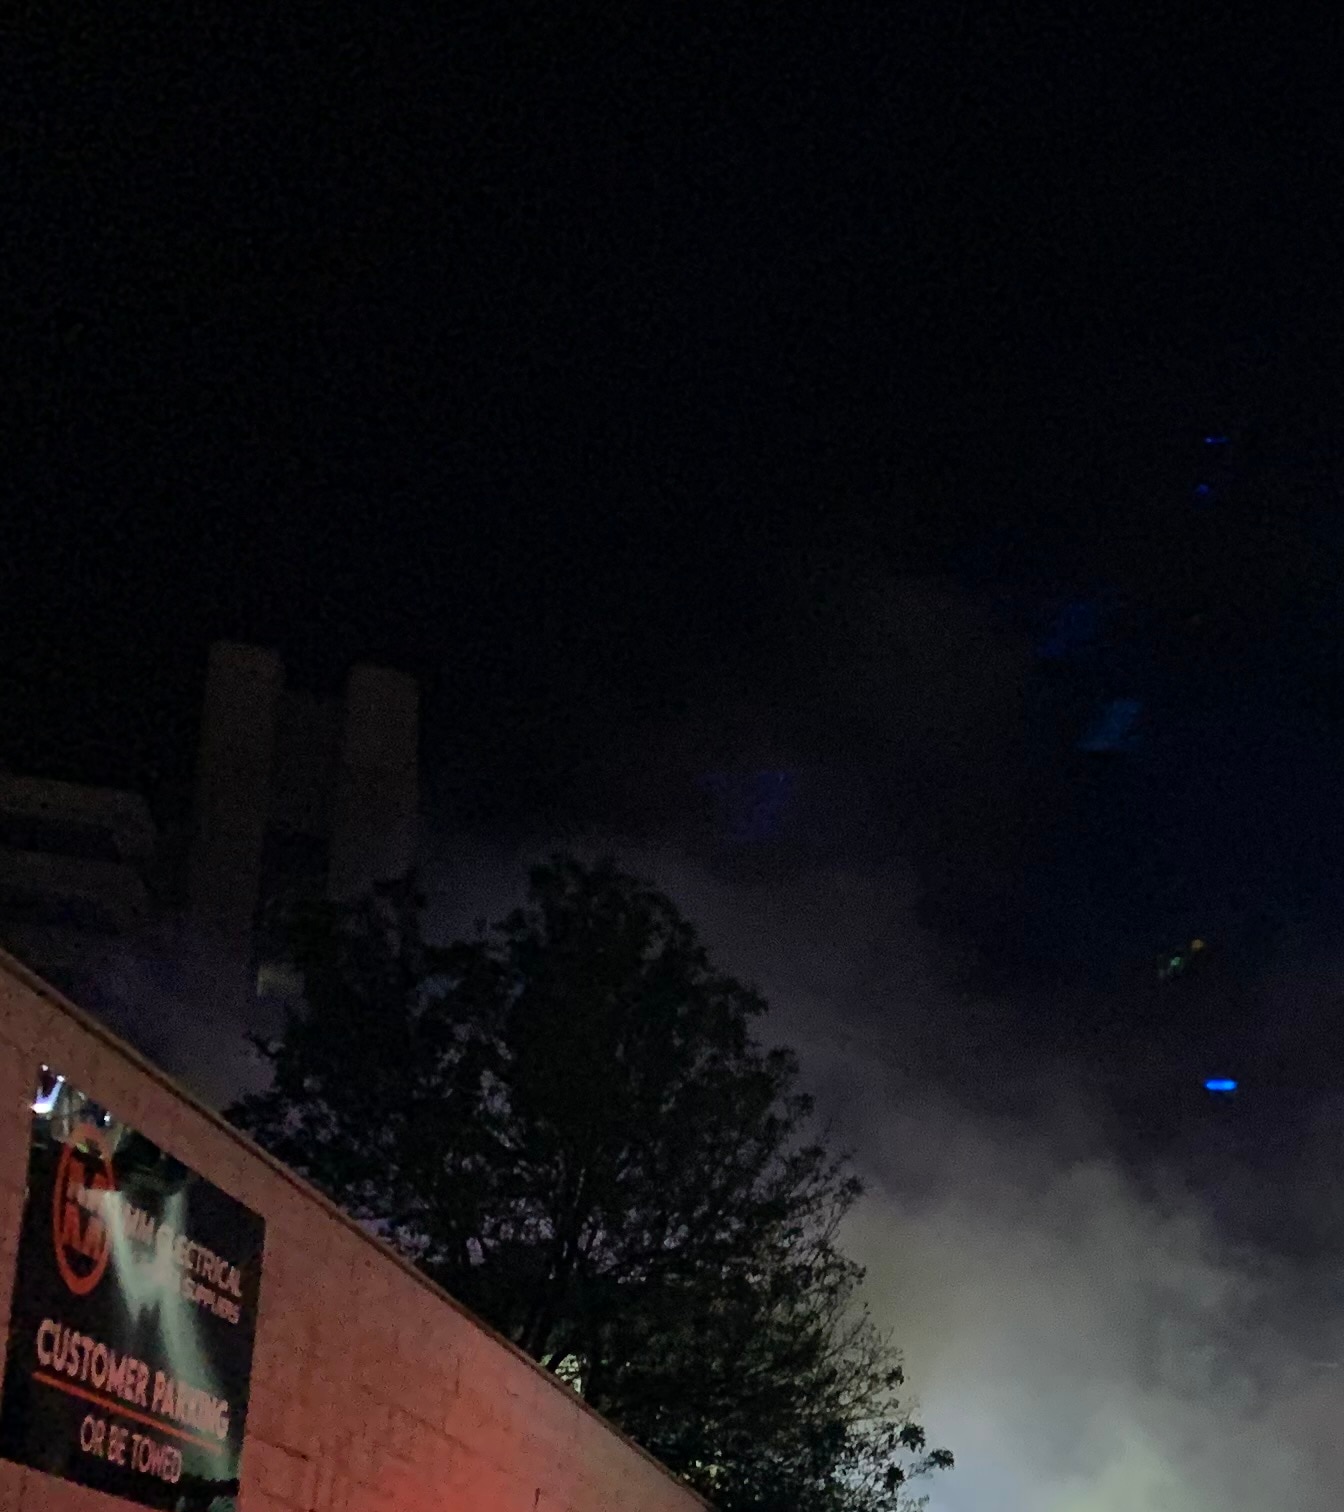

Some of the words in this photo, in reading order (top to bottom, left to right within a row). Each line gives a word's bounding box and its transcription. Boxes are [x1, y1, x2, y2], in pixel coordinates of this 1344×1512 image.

[37, 1319, 151, 1408] CUSTOMER
[151, 1370, 229, 1441] PARKING
[80, 1415, 106, 1457] OR
[107, 1425, 129, 1466] BE
[131, 1434, 182, 1484] TOWED
